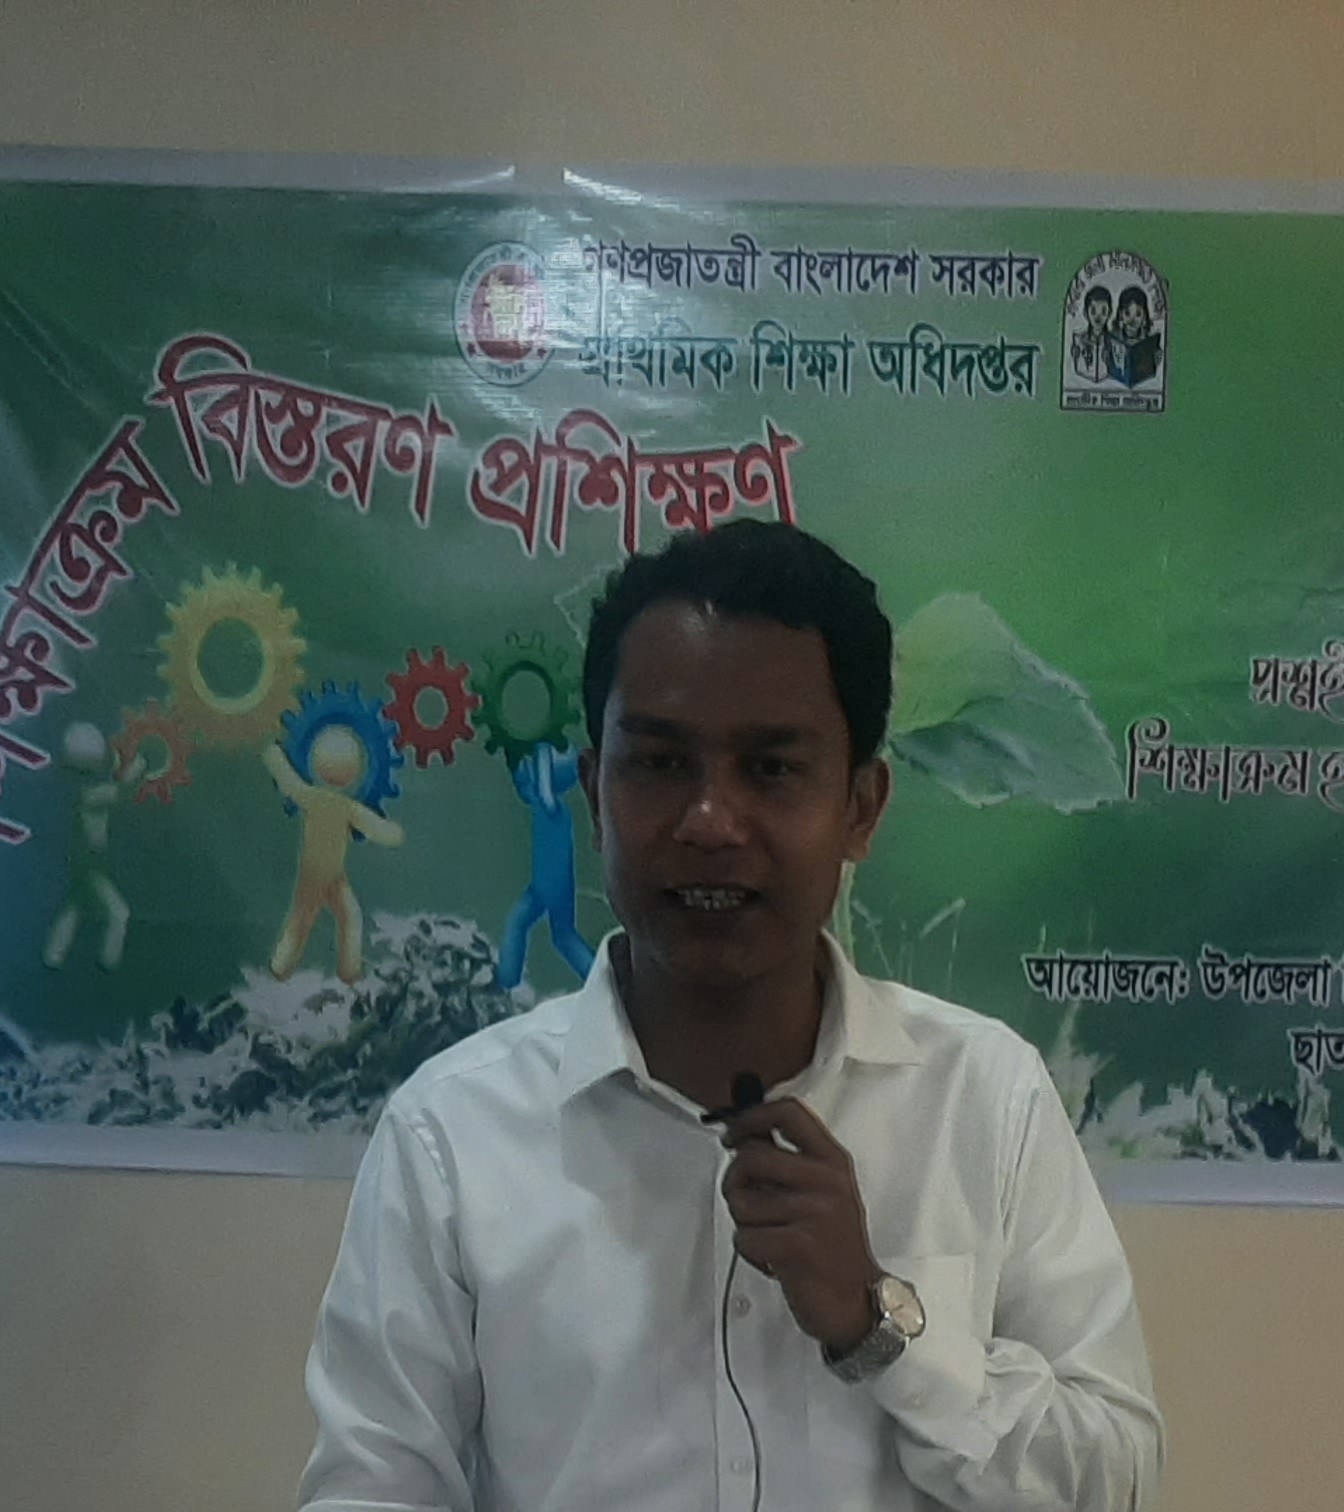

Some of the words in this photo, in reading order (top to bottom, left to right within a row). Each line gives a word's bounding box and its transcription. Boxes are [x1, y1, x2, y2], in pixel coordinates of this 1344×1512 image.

[770, 246, 920, 296] বাংলাদেশ
[928, 250, 1040, 298] সরকার
[749, 320, 855, 394] শিক্ষা
[866, 322, 1041, 398] অধিদপ্তর
[145, 333, 454, 525] বিস্তরণ
[468, 407, 802, 556] প্রশিক্ষণ
[1198, 943, 1332, 1008] উপজেলা
